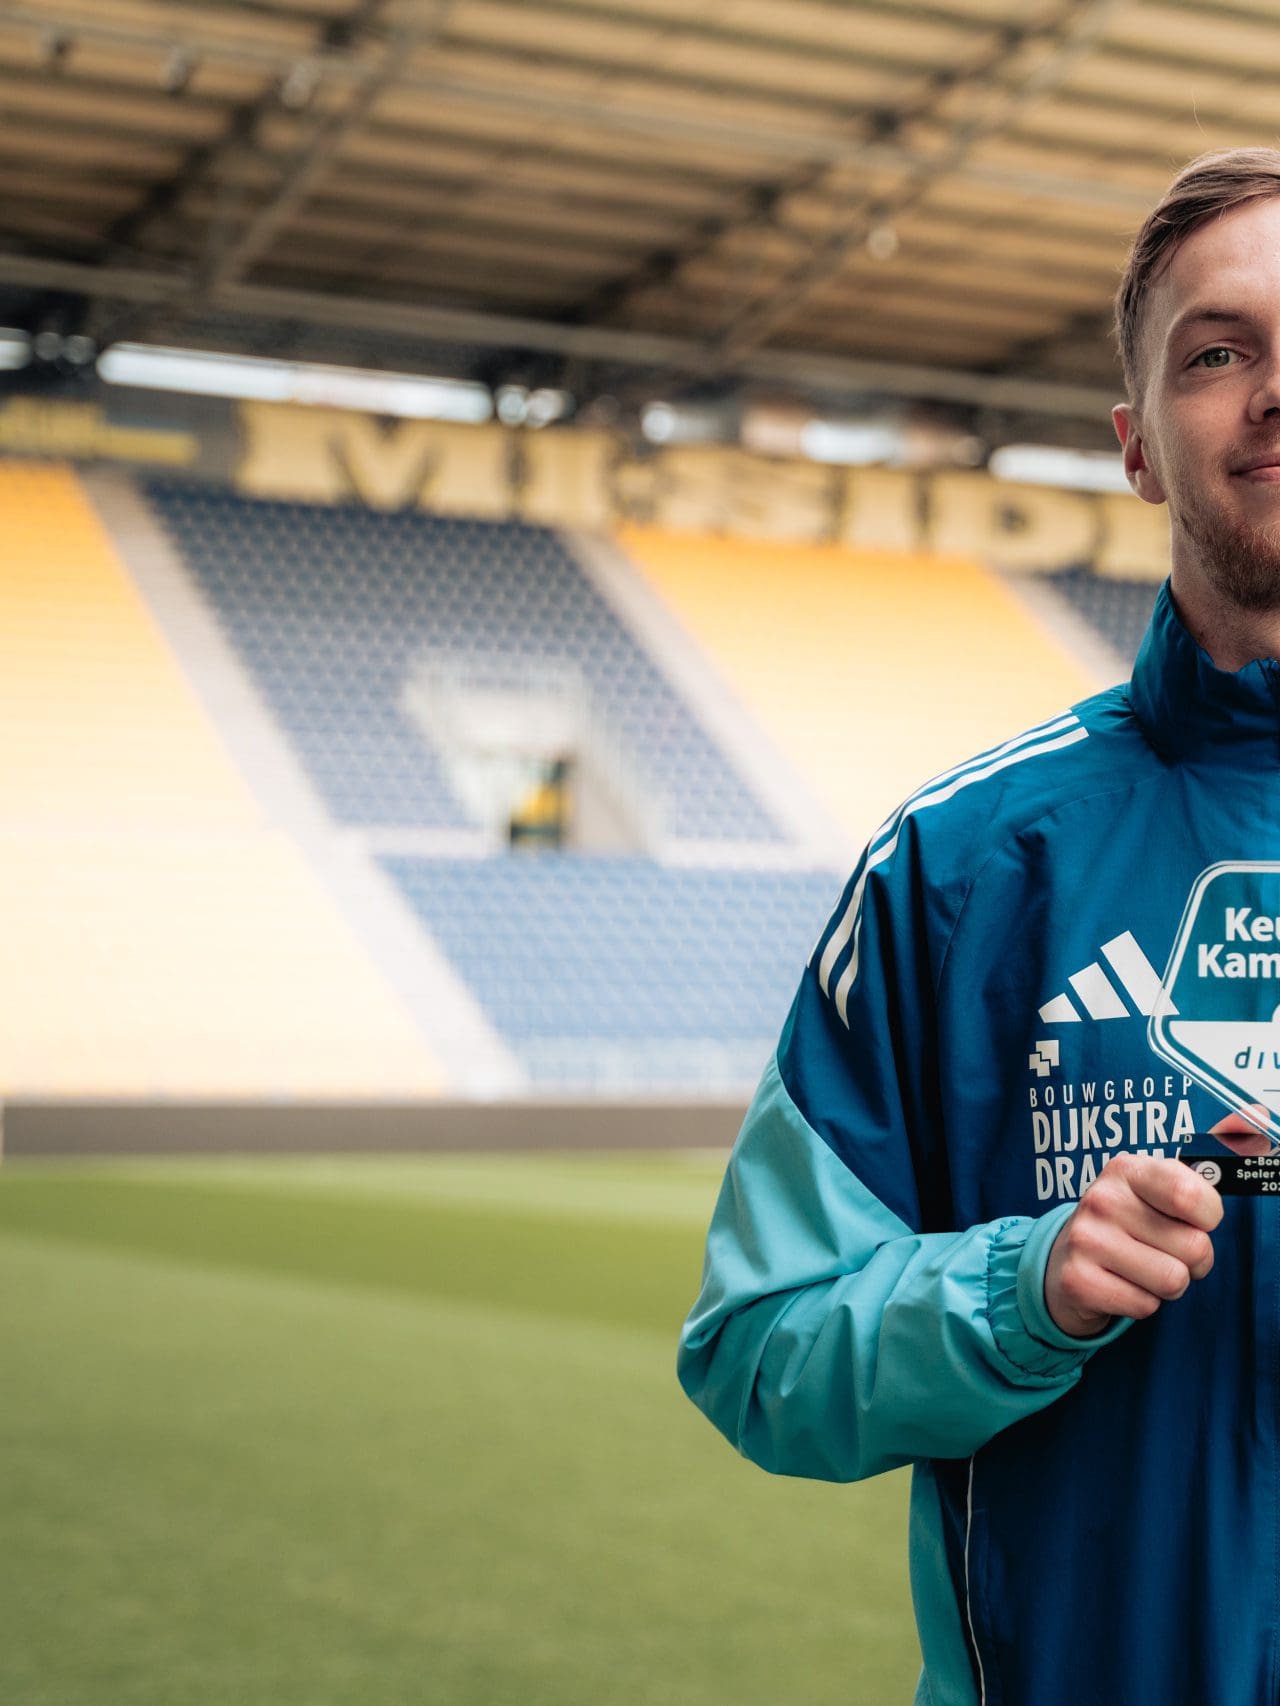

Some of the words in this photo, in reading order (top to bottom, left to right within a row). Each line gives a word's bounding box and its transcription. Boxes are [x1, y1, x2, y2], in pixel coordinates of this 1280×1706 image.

[1029, 1074, 1194, 1108] BOUWGROEP
[1032, 1099, 1196, 1154] DIJKSTRA
[1236, 1168, 1275, 1180] Speler
